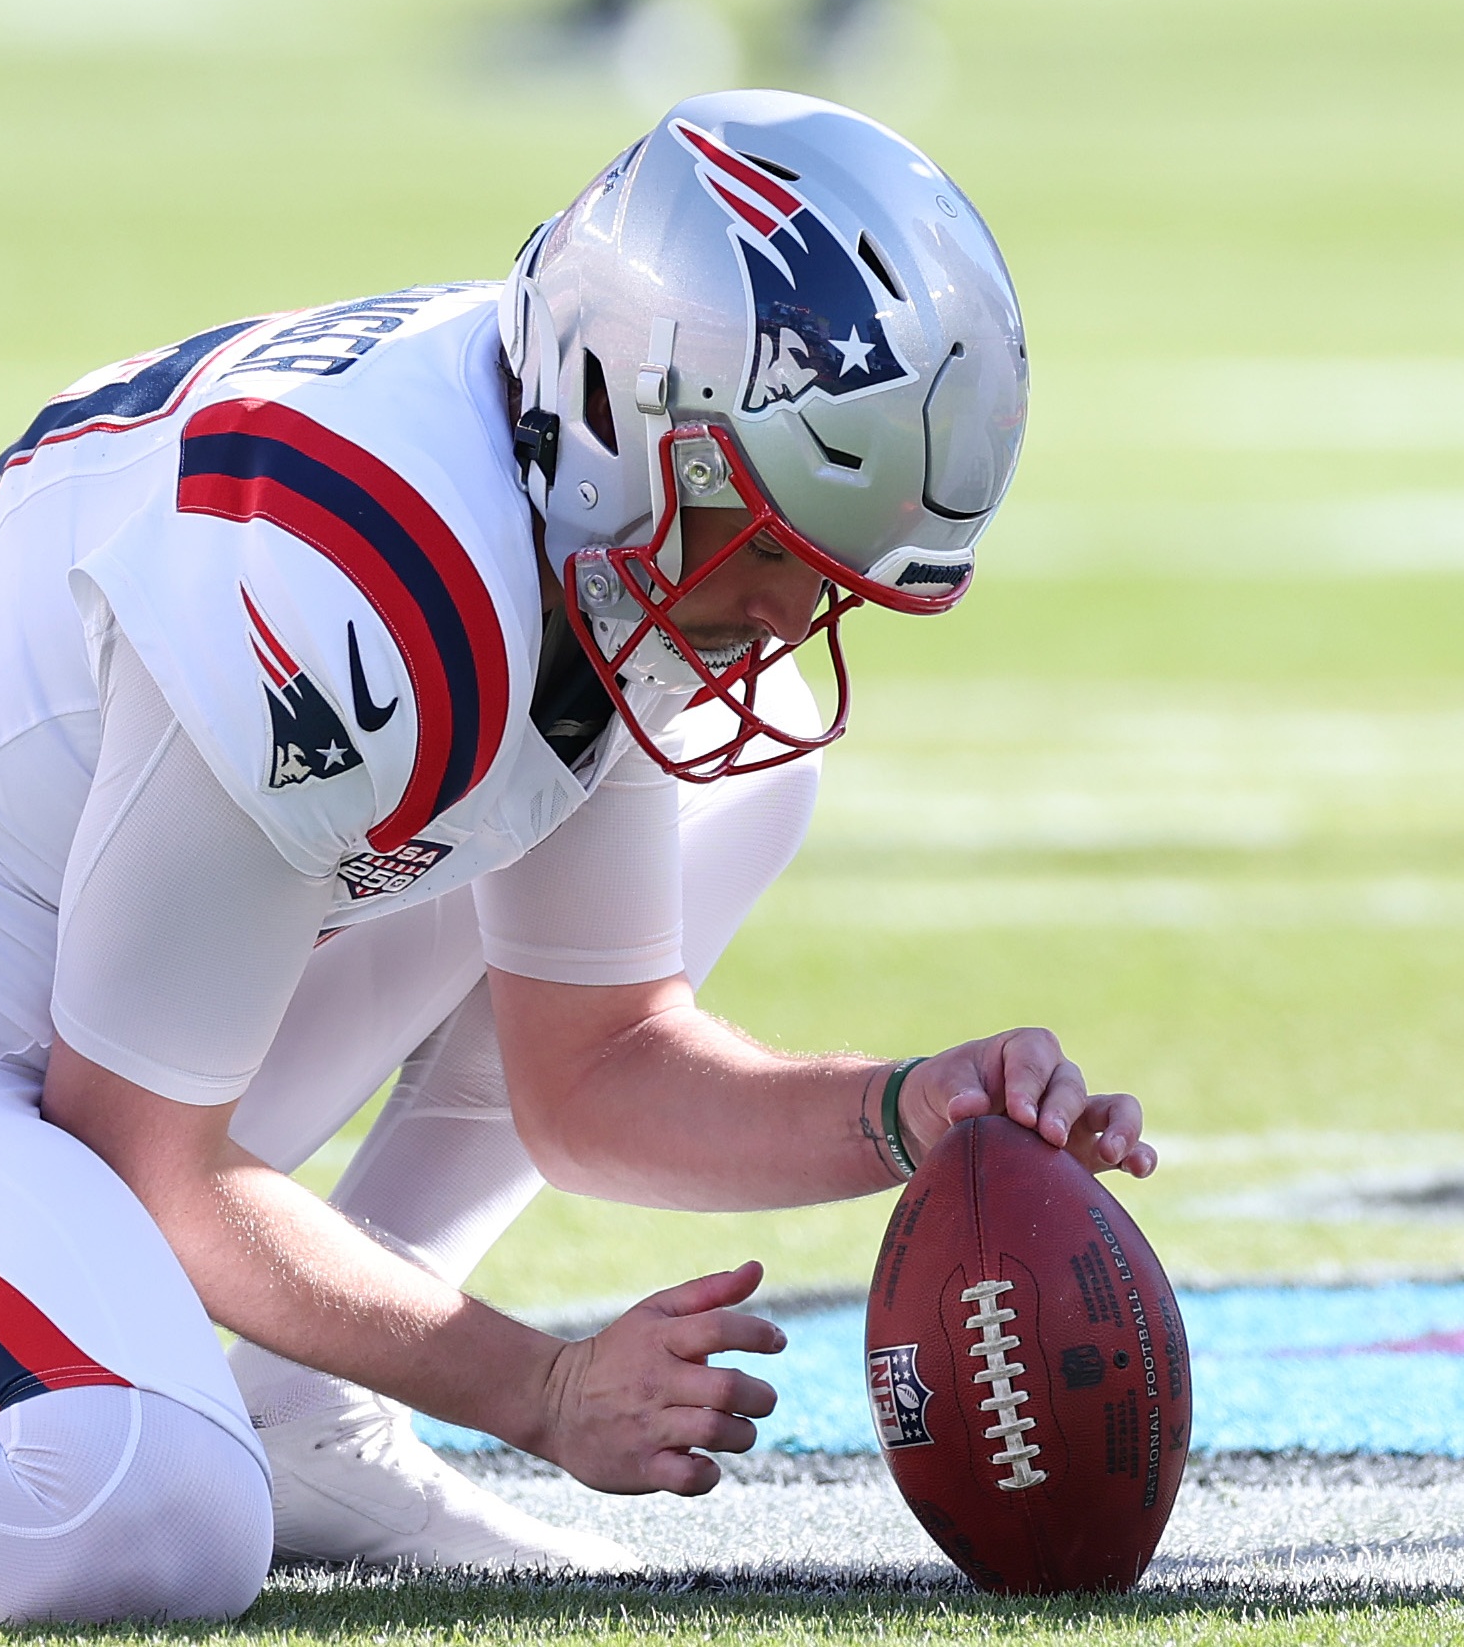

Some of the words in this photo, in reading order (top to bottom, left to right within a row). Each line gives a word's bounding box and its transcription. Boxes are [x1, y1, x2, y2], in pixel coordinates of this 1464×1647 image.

[339, 861, 416, 893] 250
[886, 1134, 895, 1142] 3
[1088, 1207, 1134, 1282] LEAGUE
[1128, 1287, 1159, 1397] FOOTBALL
[870, 1360, 899, 1429] NFL
[1143, 1405, 1160, 1509] NATIONAL
